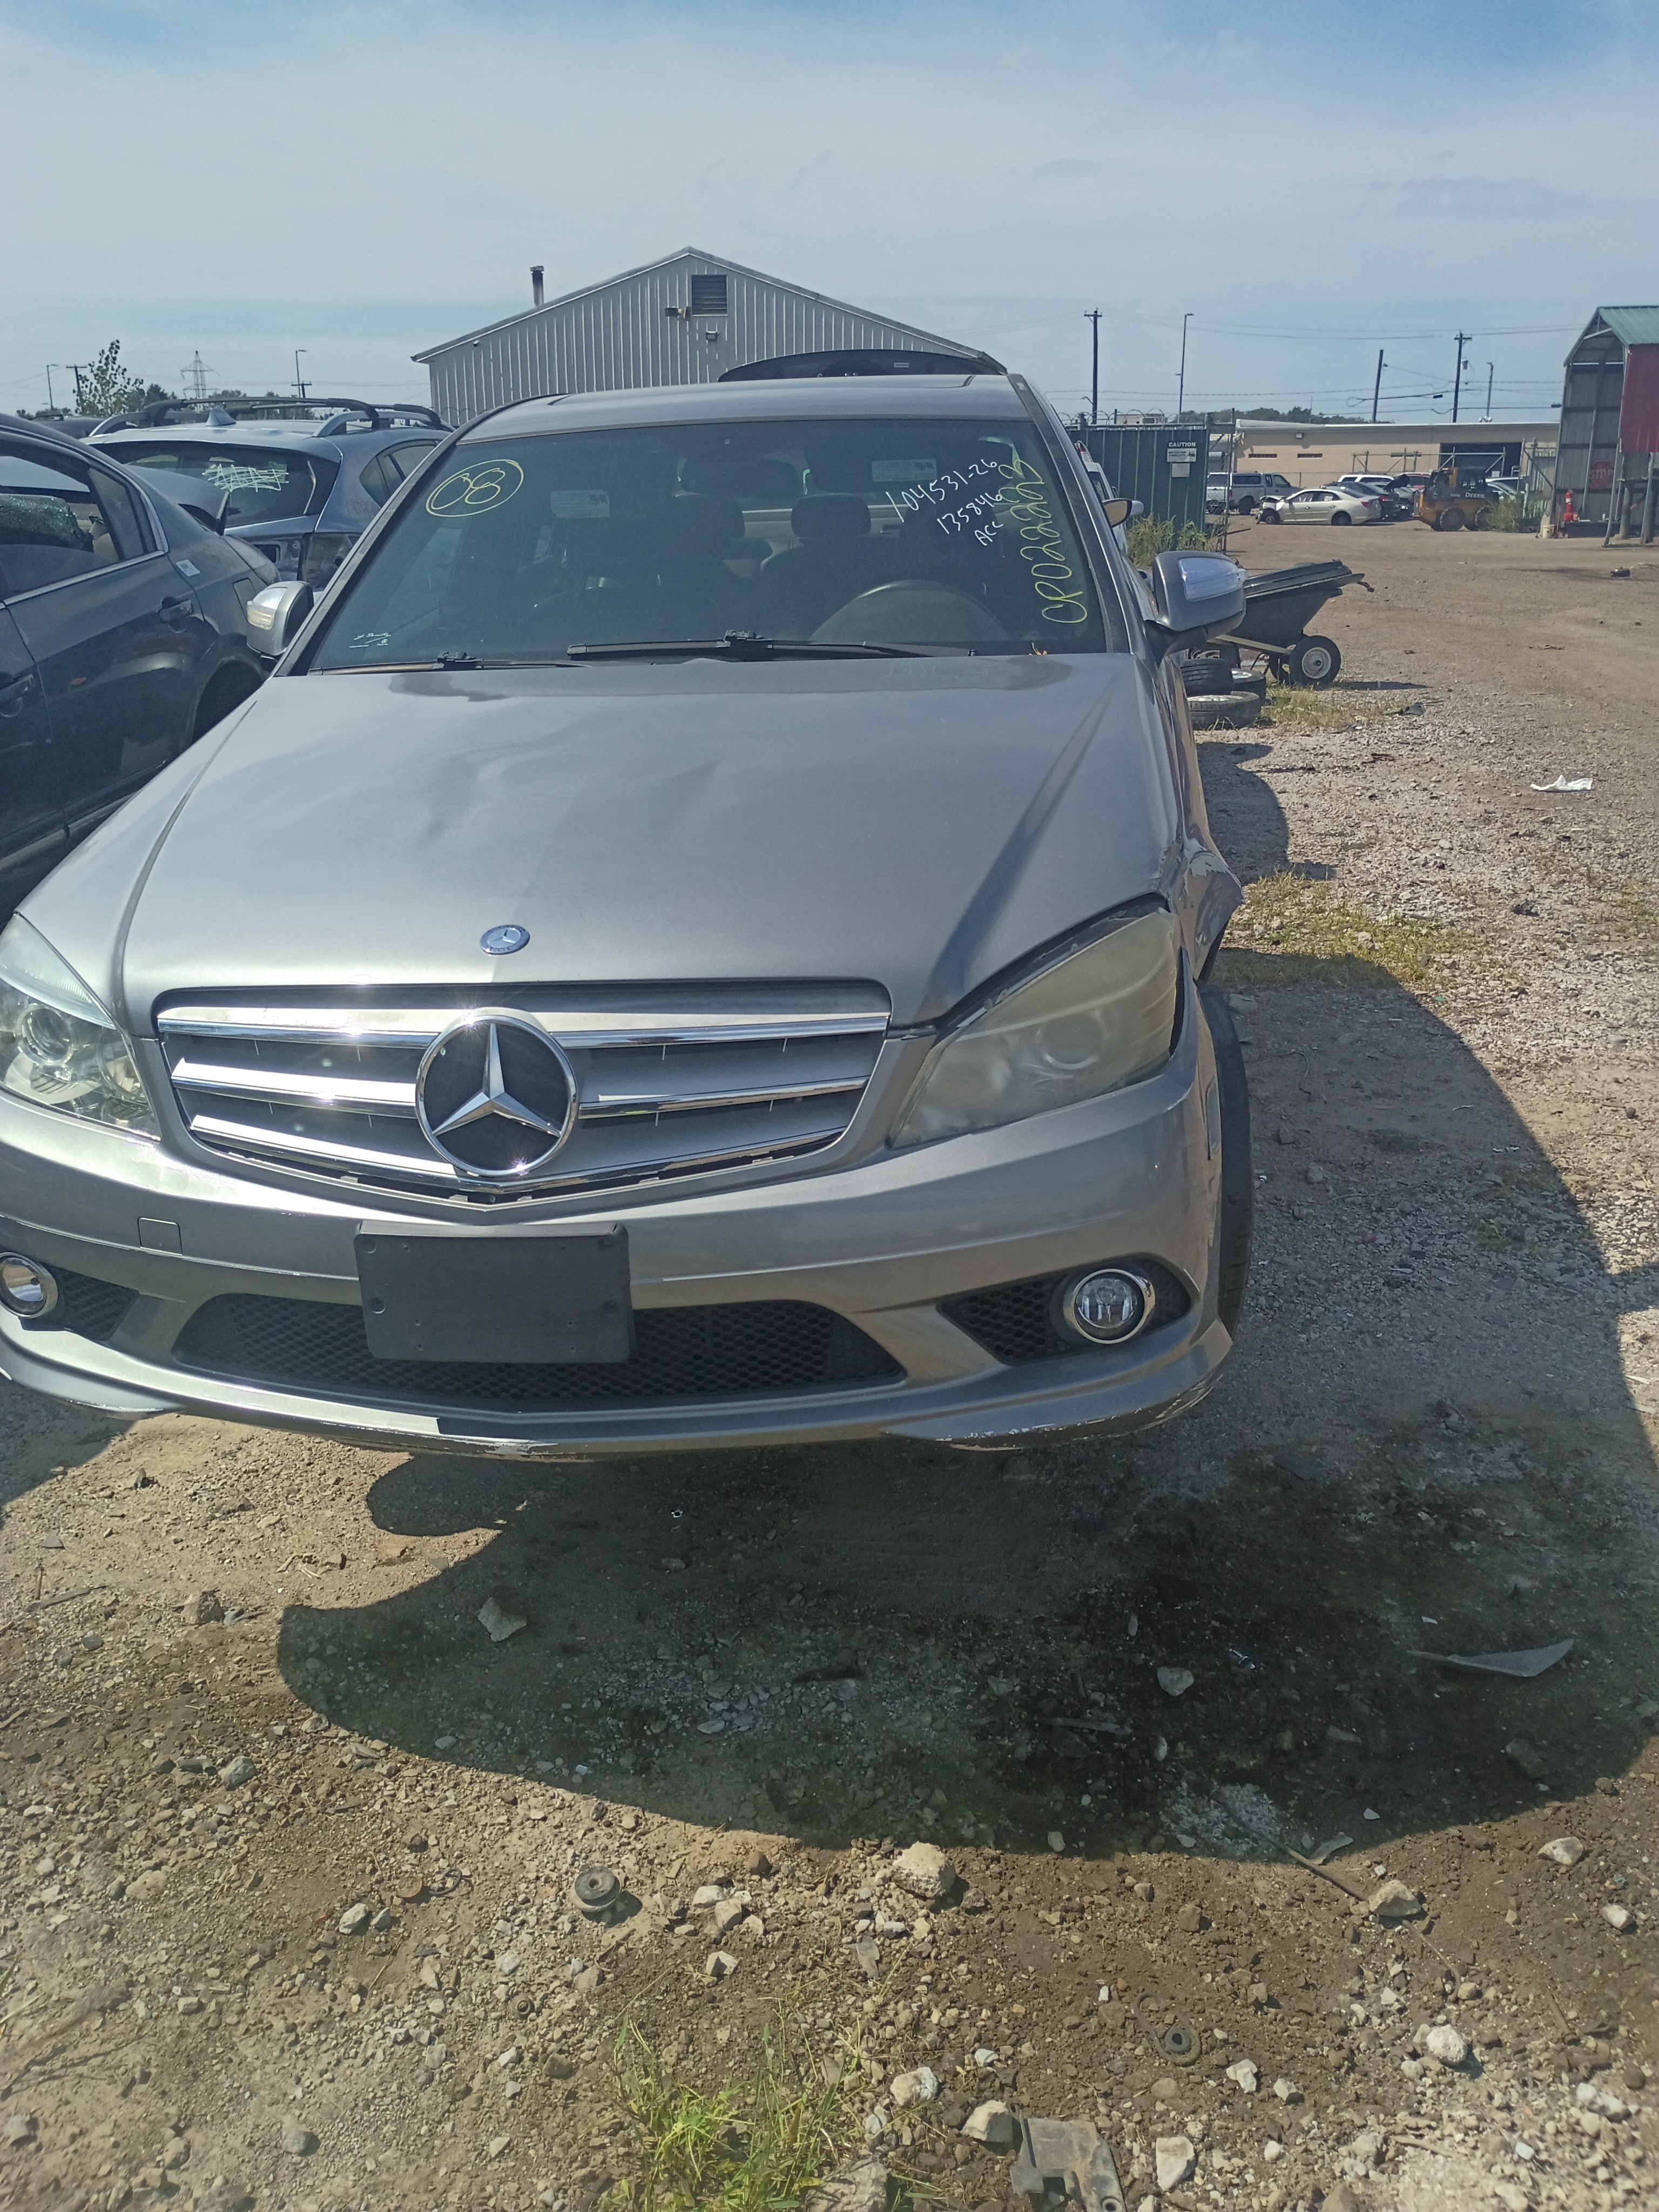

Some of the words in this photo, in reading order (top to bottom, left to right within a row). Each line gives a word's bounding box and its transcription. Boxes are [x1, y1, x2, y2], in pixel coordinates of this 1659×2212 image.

[430, 468, 505, 510] 08
[886, 459, 998, 523] 104531-26
[1589, 469, 1614, 480] STOP
[937, 492, 1003, 535] 135846
[974, 523, 1004, 546] ACC
